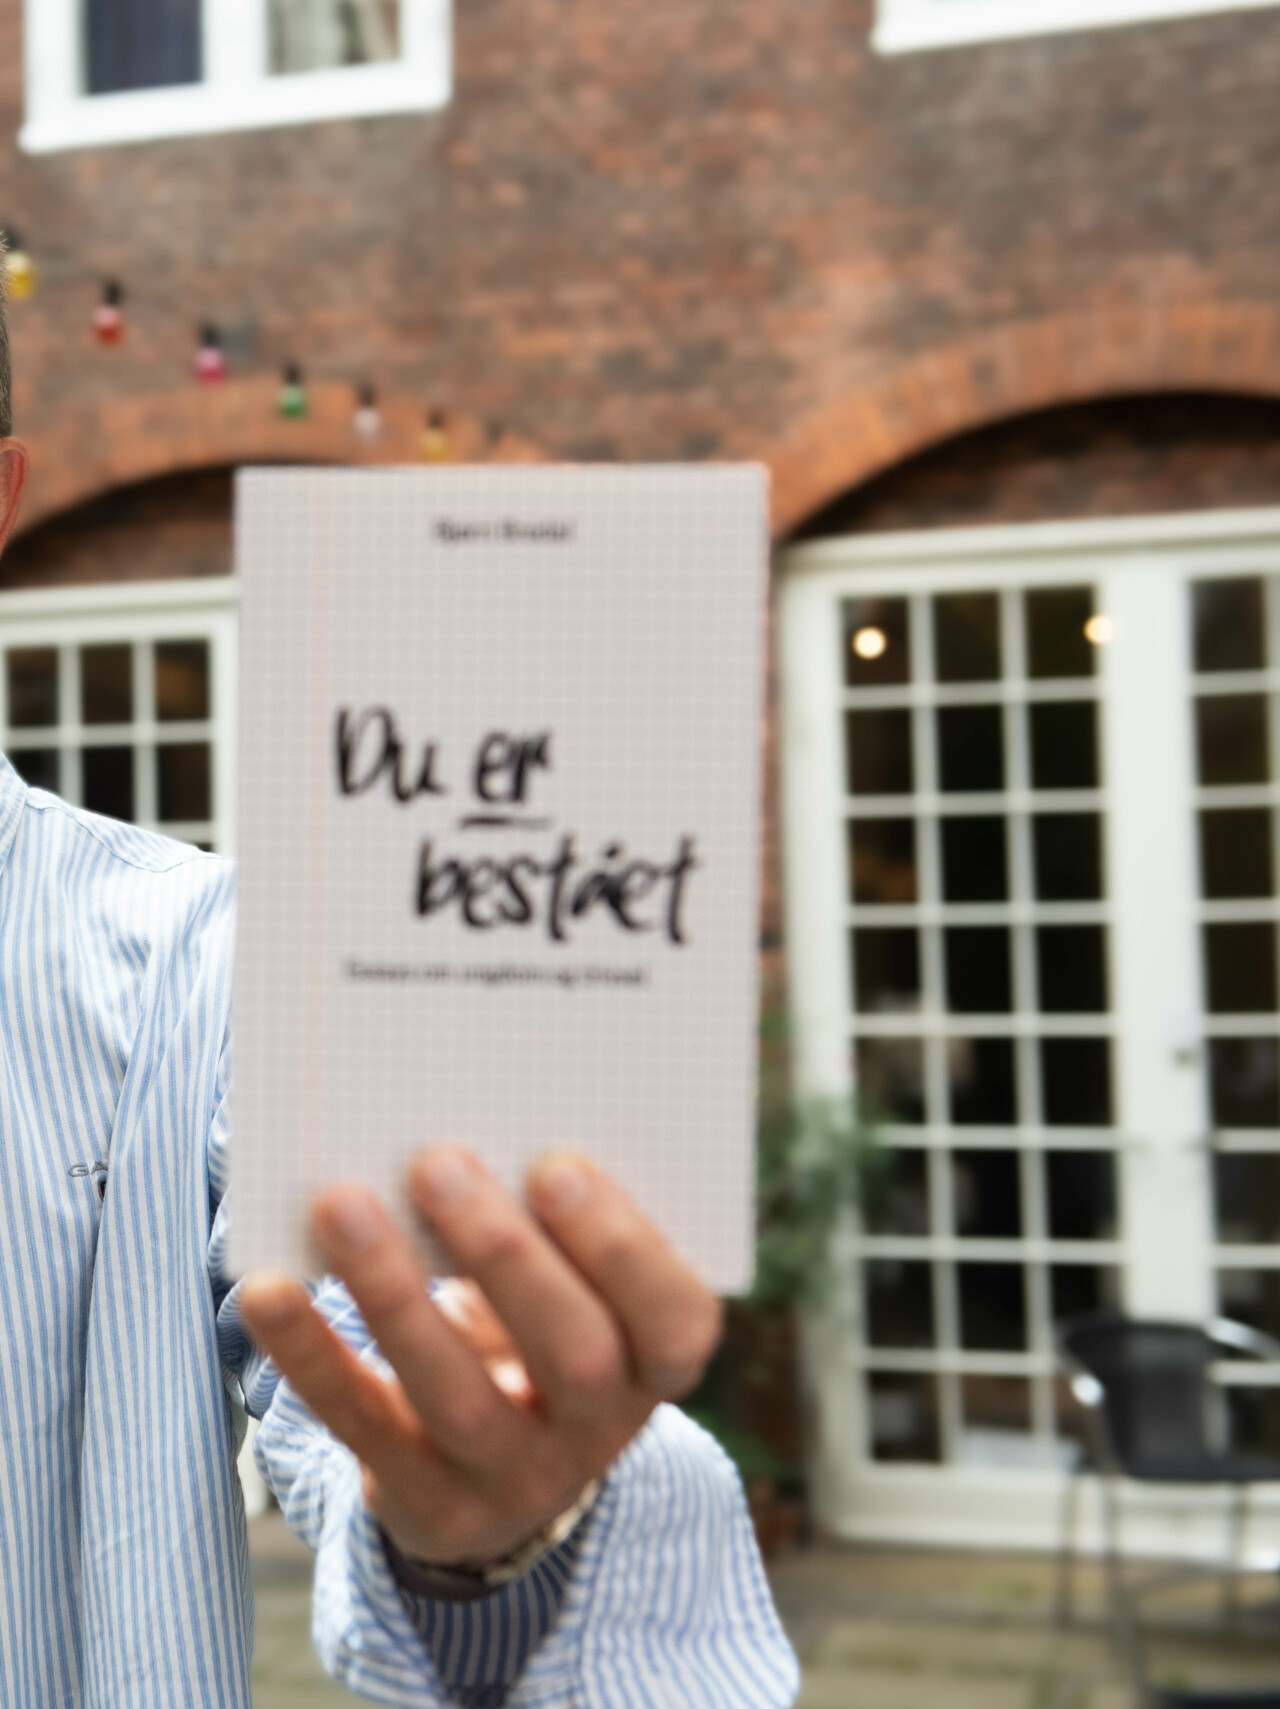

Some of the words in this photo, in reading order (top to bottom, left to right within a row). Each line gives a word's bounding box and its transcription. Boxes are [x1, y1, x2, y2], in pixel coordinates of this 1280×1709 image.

[333, 704, 448, 807] Du
[473, 730, 552, 806] er
[69, 1160, 108, 1177] GA
